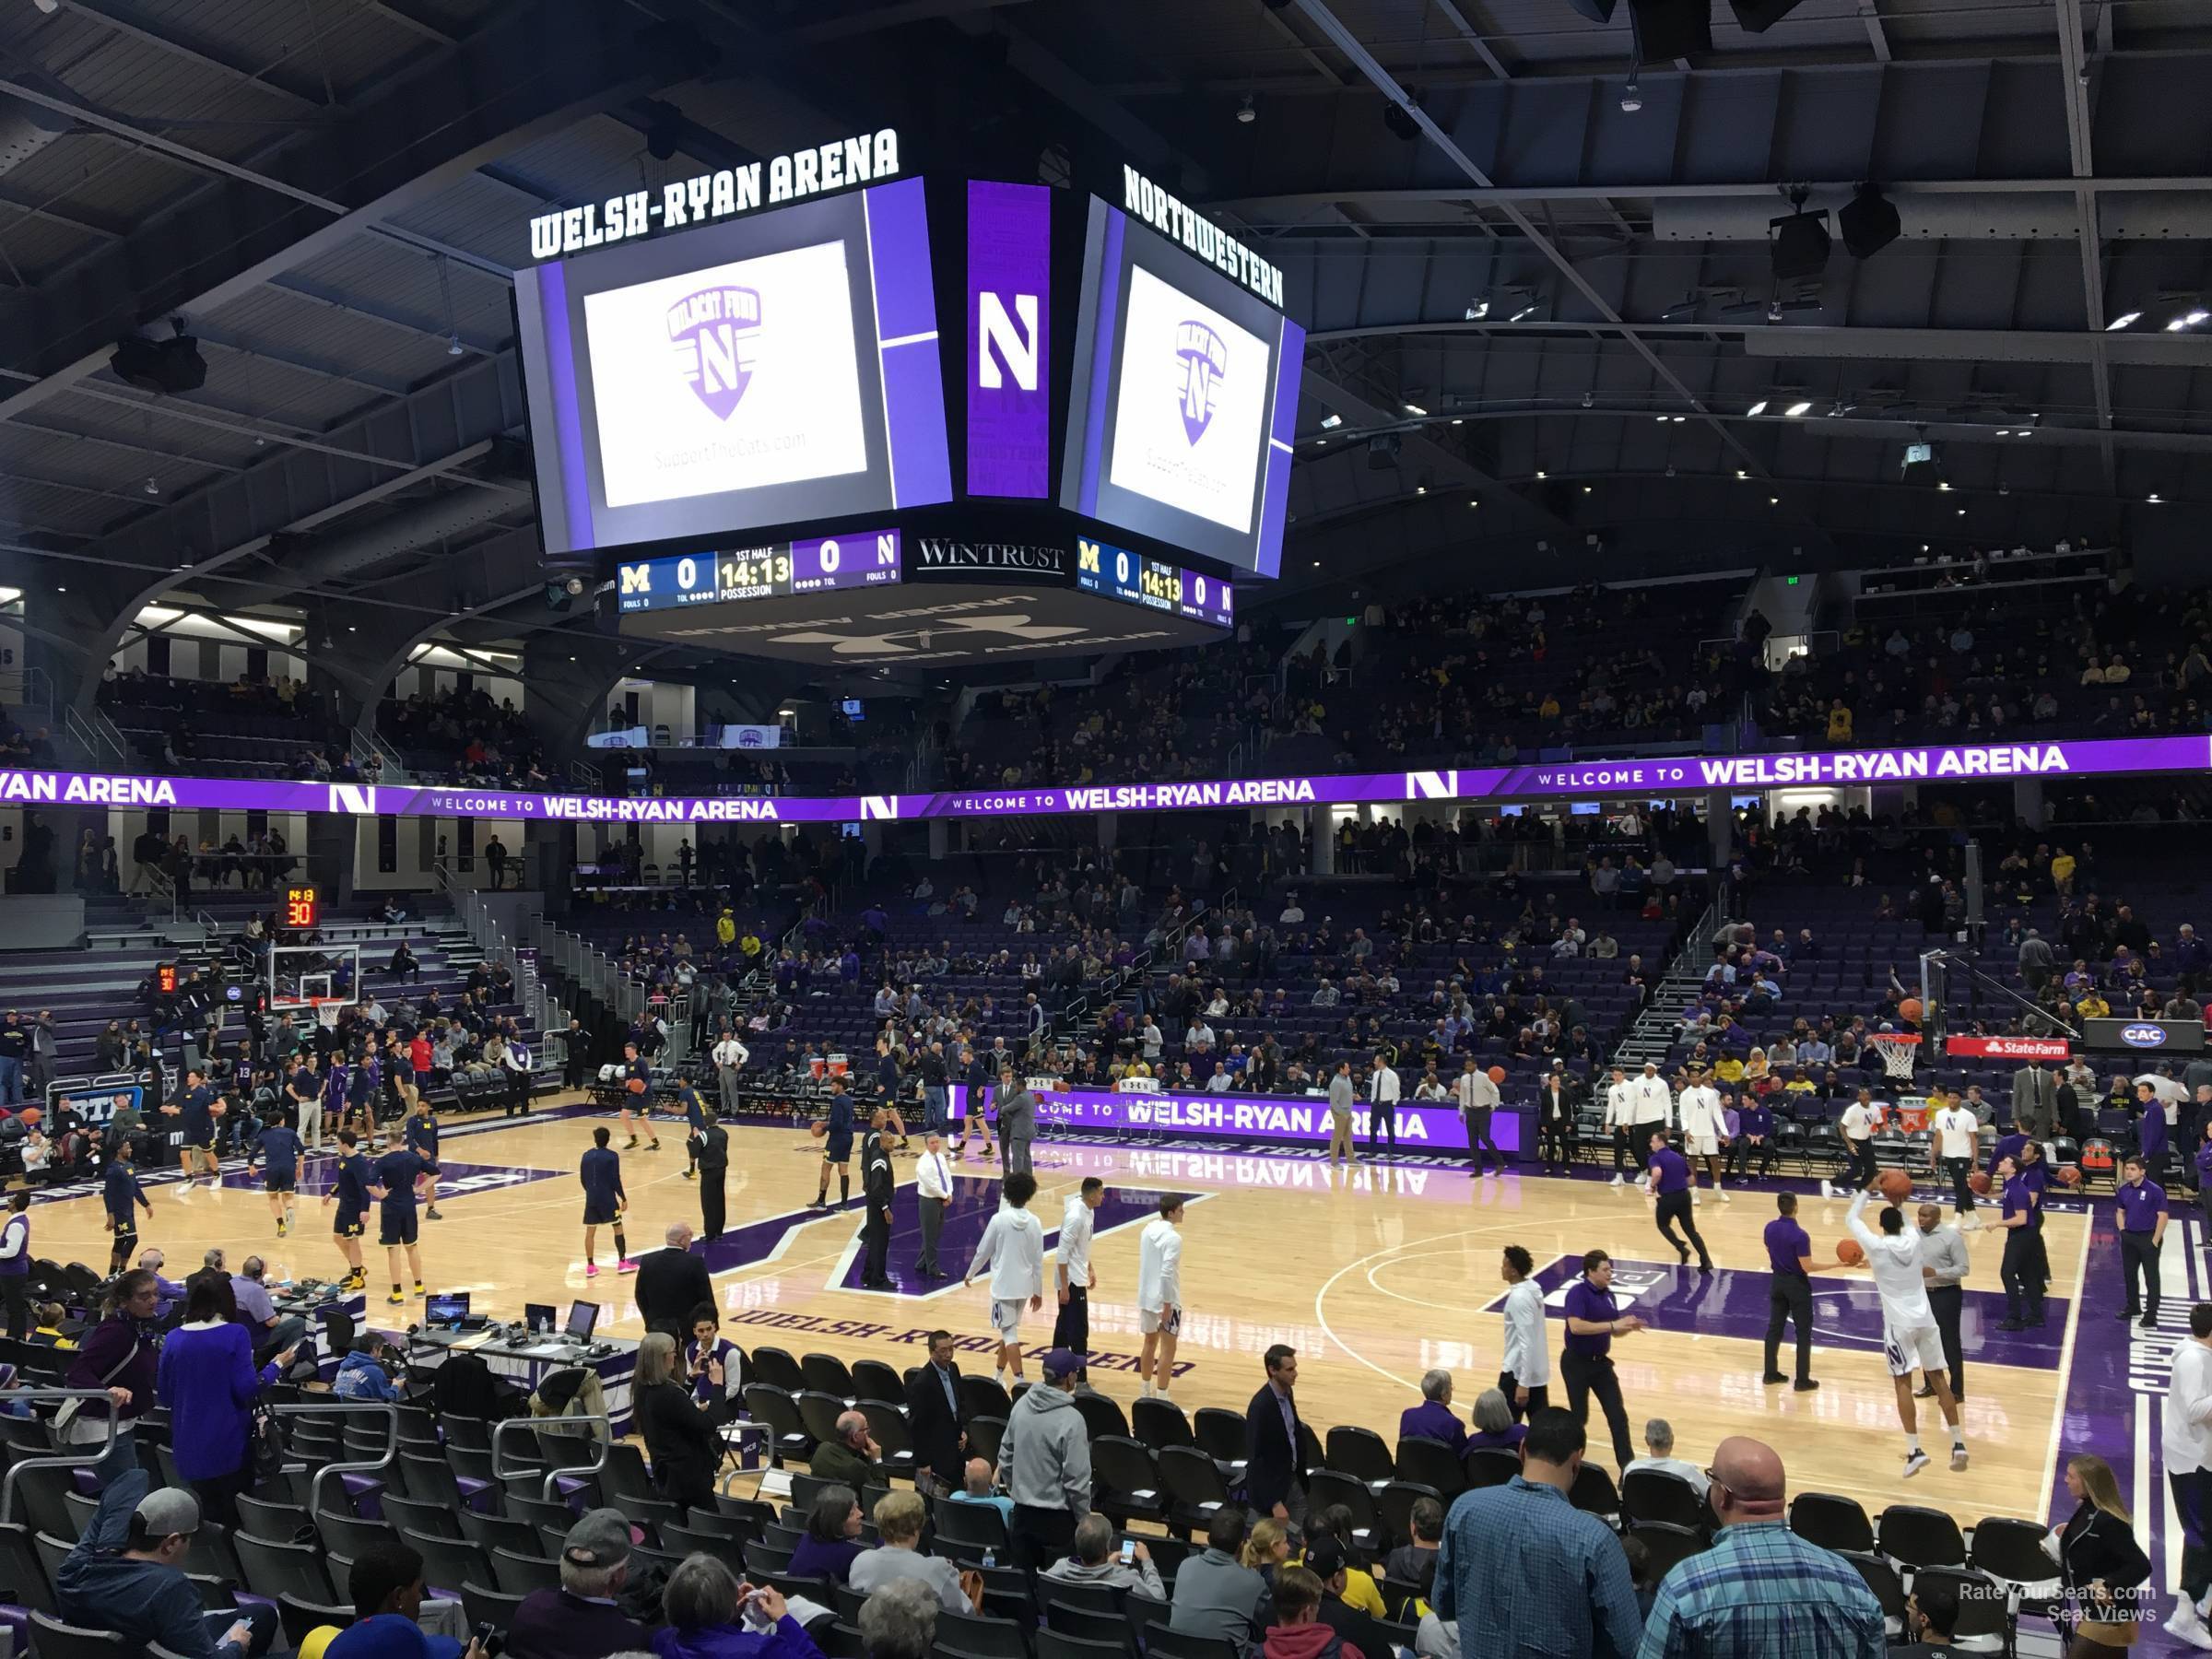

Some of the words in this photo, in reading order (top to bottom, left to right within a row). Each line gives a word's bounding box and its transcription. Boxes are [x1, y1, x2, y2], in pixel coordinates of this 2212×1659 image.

[530, 162, 761, 259] WELSH-RYAN
[769, 128, 900, 203] ARENA
[1124, 163, 1284, 308] NORTHWESTERN
[979, 291, 1038, 391] N
[699, 324, 738, 394] N
[736, 549, 750, 561] 1ST
[751, 547, 773, 559] HALF
[820, 540, 840, 572] 0
[877, 534, 895, 564] N
[1079, 540, 1100, 573] M
[620, 563, 652, 594] M
[677, 558, 696, 589] 0
[721, 557, 790, 587] 14:13
[824, 577, 836, 586] TOL
[866, 571, 887, 582] FOULS
[1116, 552, 1129, 583] 0
[1159, 564, 1172, 575] HALF
[721, 585, 772, 600] POSSESSION
[1142, 570, 1181, 602] 14:13
[1194, 576, 1206, 605] 0
[1222, 585, 1231, 611] N
[623, 599, 641, 609] FOULS
[1142, 594, 1171, 610] POSSESSION
[1538, 770, 1644, 787] WELCOME
[1656, 768, 1685, 782] TO
[1700, 750, 1928, 784] WELSH-RYAN
[1936, 746, 2069, 775] ARENA
[64, 776, 177, 805] ARENA
[953, 797, 1028, 811] WELCOME
[1035, 795, 1055, 807] TO
[1065, 783, 1219, 810] WELSH-RYAN
[1226, 780, 1315, 803] ARENA
[432, 797, 507, 811] WELCOME
[516, 799, 534, 812] TO
[543, 796, 683, 819] WELSH-RYAN
[689, 800, 778, 819] ARENA
[289, 890, 313, 902] 14:13
[288, 903, 311, 924] 30
[2124, 1030, 2161, 1041] CAC
[240, 1067, 250, 1078] 13
[1039, 1102, 1083, 1116] COME
[1092, 1104, 1112, 1116] TO
[1128, 1100, 1312, 1132] WELSH-RYAN
[1947, 1116, 1956, 1131] N
[728, 1310, 1030, 1354] WELSH-RAN
[1887, 1345, 1903, 1366] N
